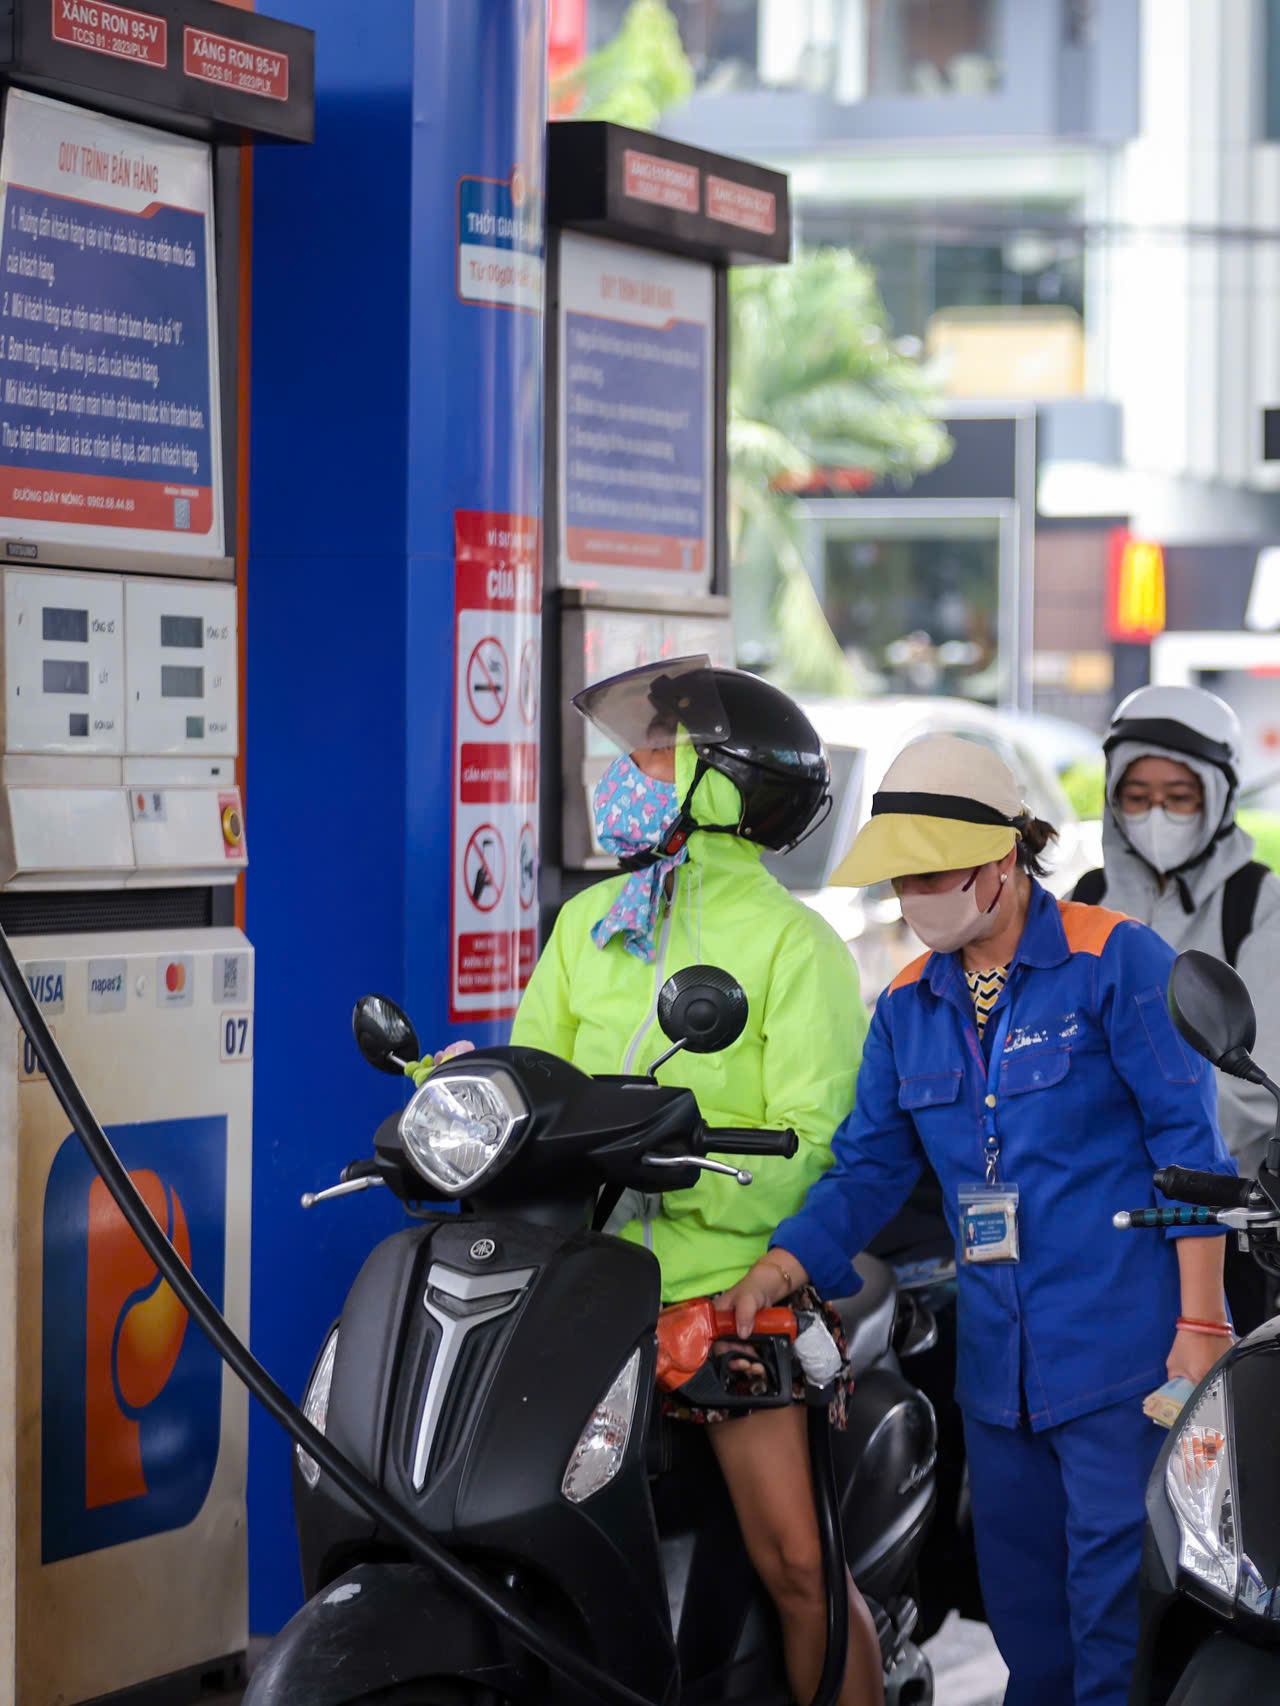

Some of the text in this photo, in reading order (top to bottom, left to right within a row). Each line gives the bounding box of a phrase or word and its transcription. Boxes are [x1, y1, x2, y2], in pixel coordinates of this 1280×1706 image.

[62, 0, 158, 43] XĂNG RON 95-V
[72, 26, 95, 45] TCCS
[193, 37, 280, 78] XĂNG RON 95-V
[202, 62, 222, 81] TCCS
[58, 141, 159, 193] QUY TRÌNH BÁN HÀNG
[466, 209, 496, 235] THỜI
[43, 488, 60, 504] DÂY
[31, 973, 65, 1003] VISA
[91, 976, 115, 998] napas
[225, 1017, 249, 1054] 07
